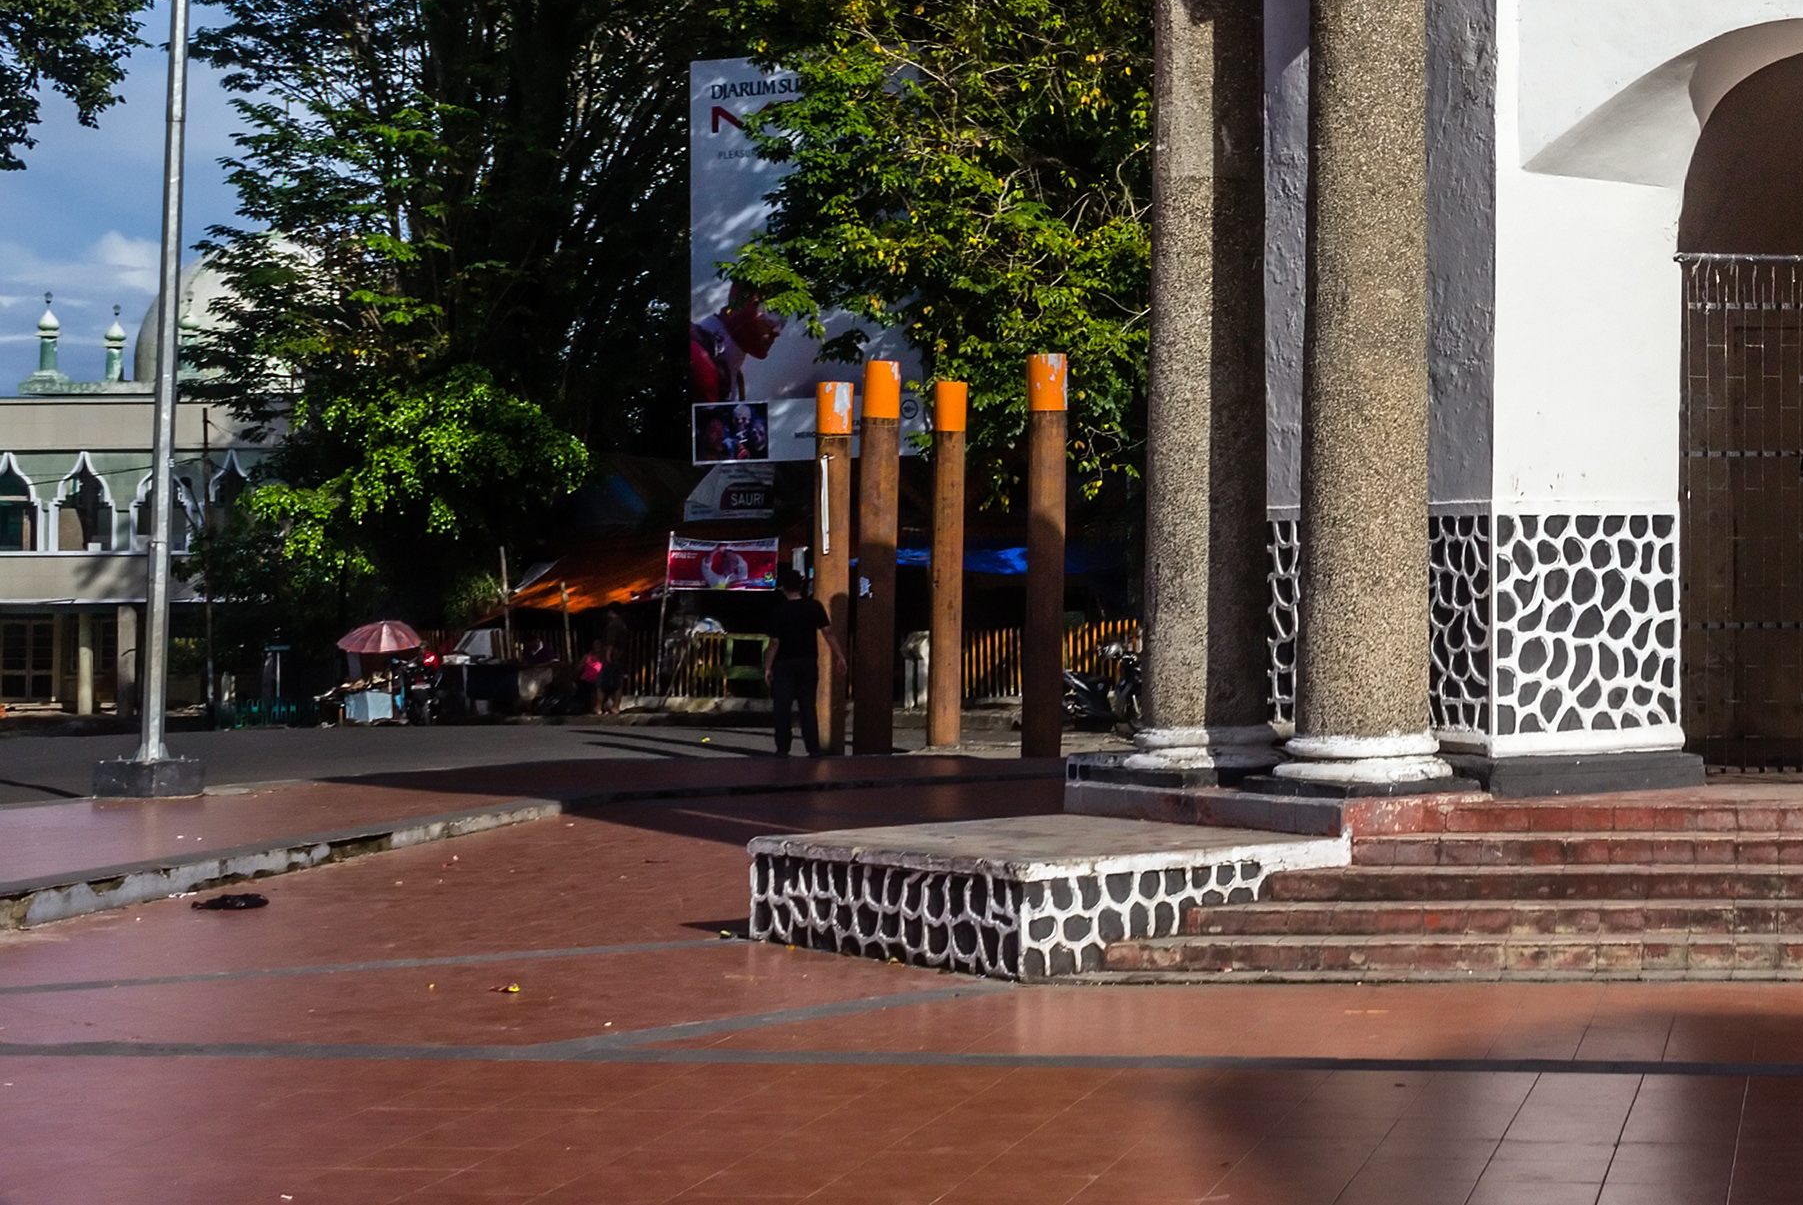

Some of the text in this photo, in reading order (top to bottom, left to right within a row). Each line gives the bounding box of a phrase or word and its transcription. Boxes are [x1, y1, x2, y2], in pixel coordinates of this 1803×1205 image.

[711, 77, 803, 100] DJARUM SU
[730, 492, 765, 507] SAURI
